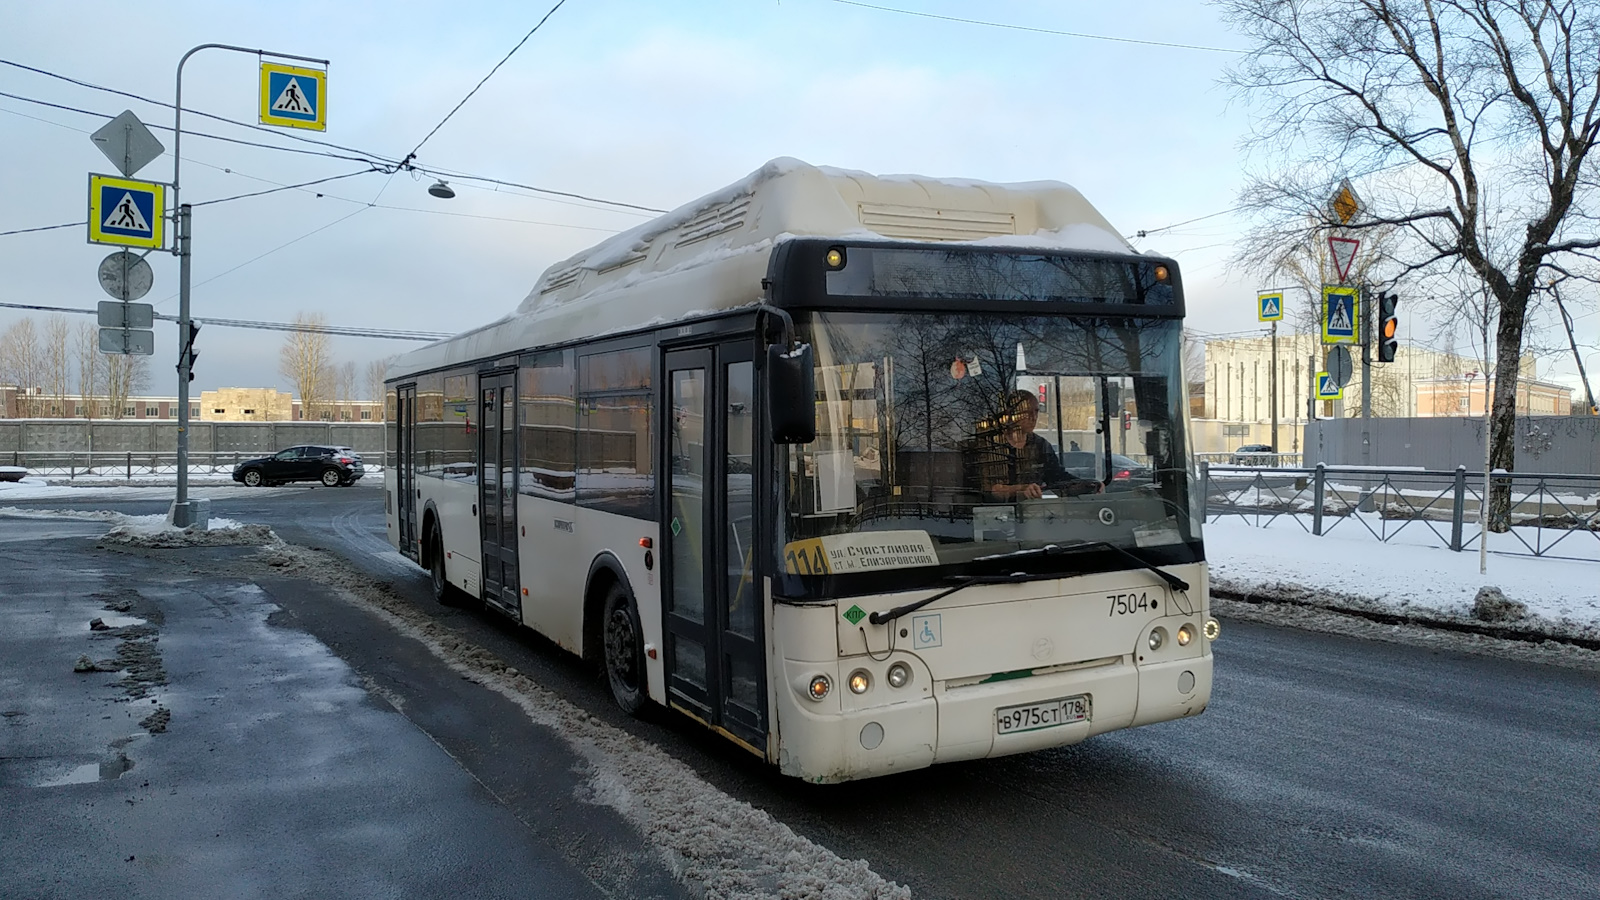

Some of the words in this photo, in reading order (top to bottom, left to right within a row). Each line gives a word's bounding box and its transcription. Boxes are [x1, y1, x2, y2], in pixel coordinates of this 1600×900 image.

[787, 545, 828, 575] 114
[846, 610, 863, 619] КПГ
[1106, 592, 1148, 617] 7504
